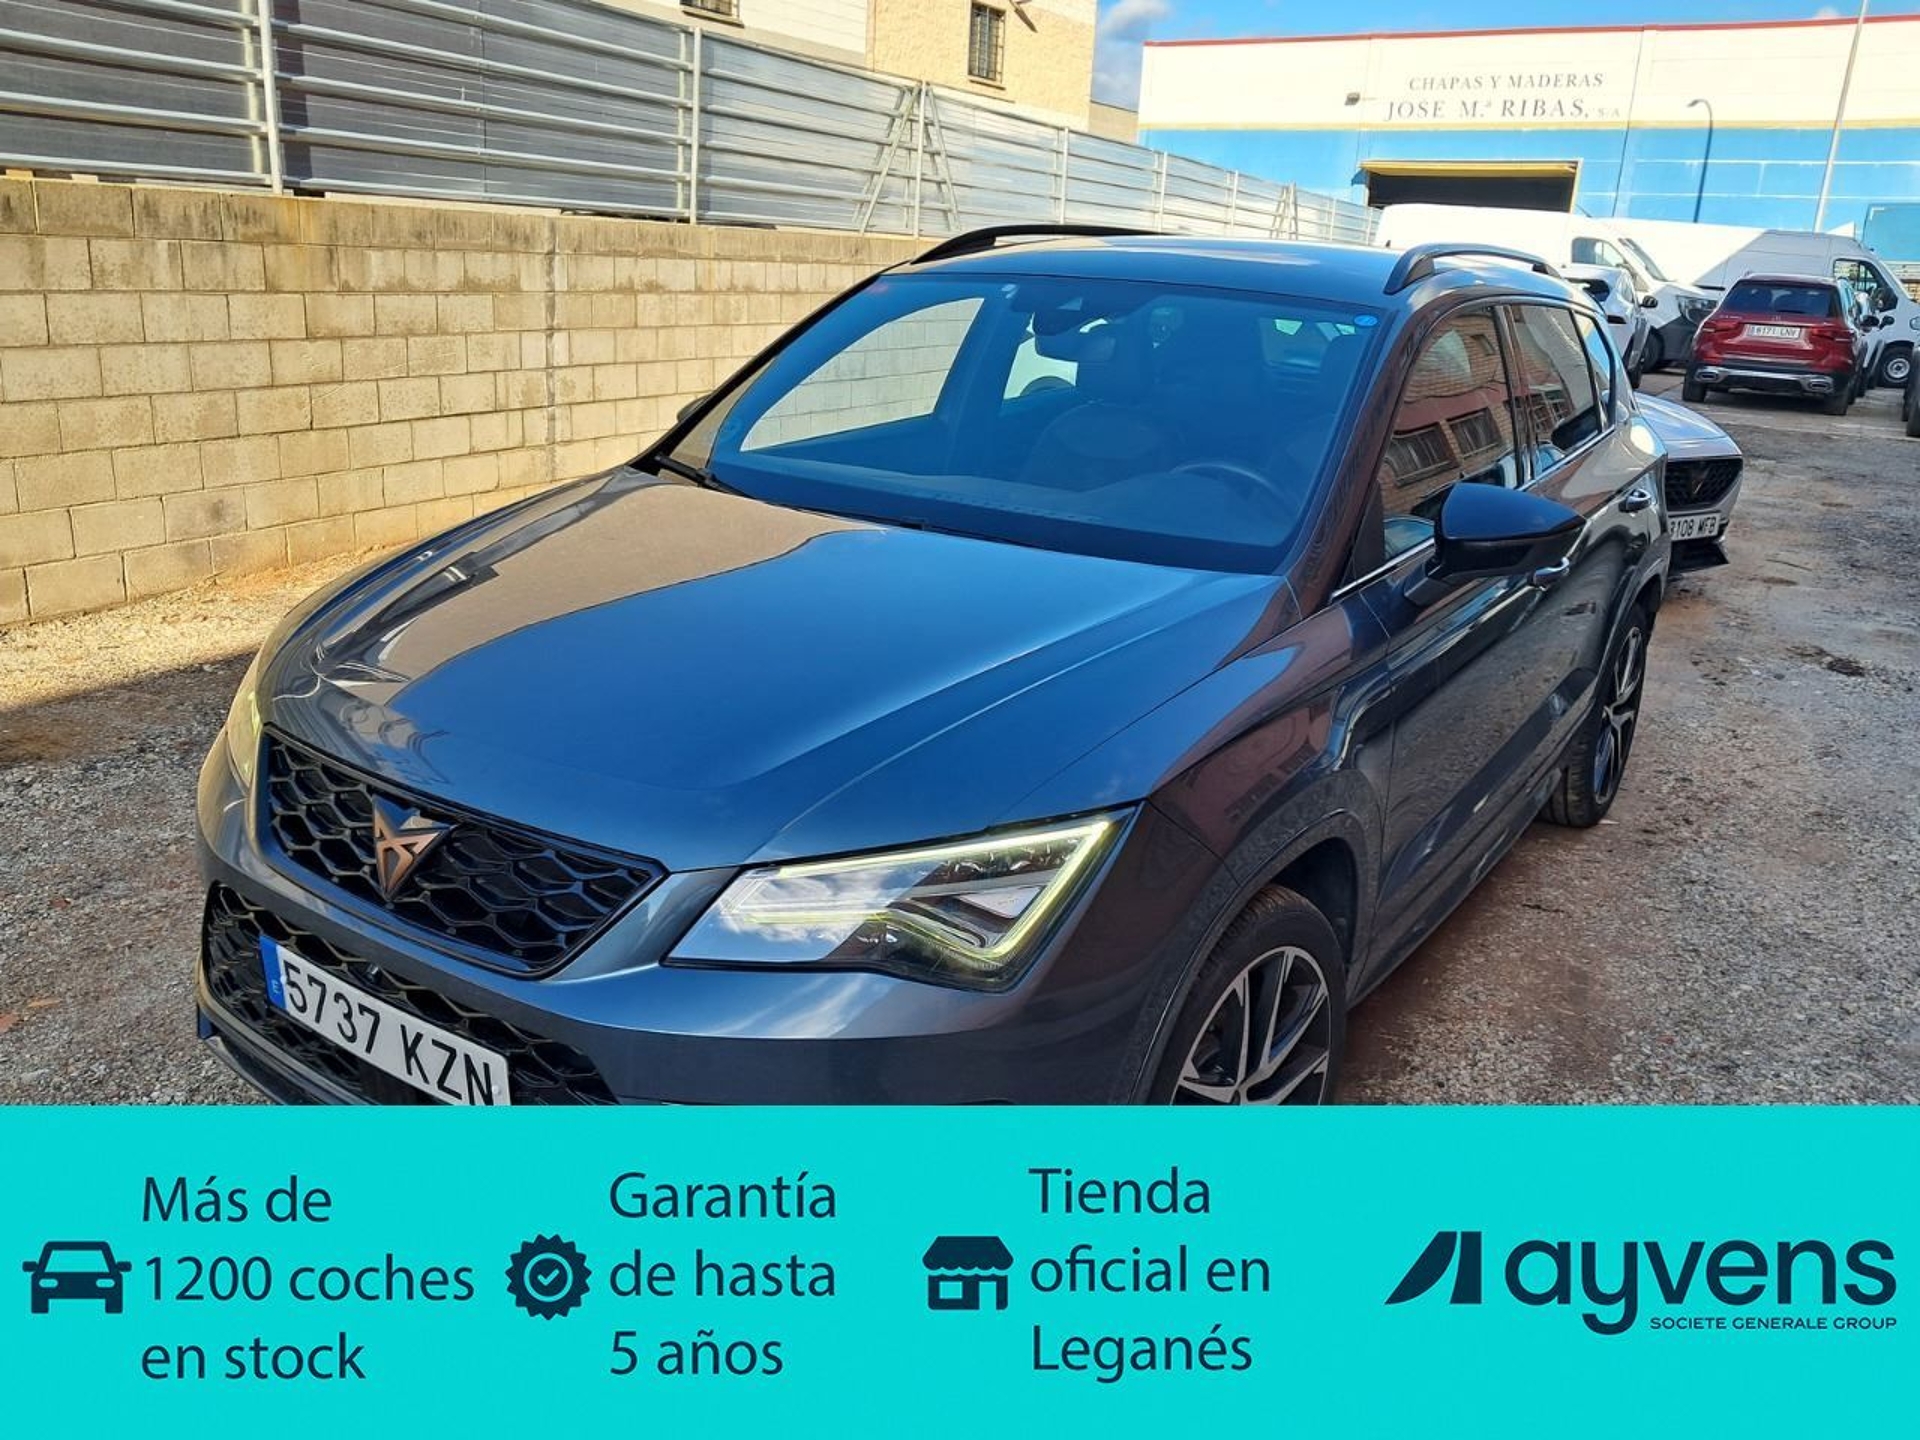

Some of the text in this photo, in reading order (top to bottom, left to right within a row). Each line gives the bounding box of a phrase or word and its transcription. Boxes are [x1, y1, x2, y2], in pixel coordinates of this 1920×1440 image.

[1408, 72, 1604, 91] CHAPAS Y MADERAS
[1384, 100, 1446, 121] JOSE
[281, 957, 494, 1106] 5737 KZN
